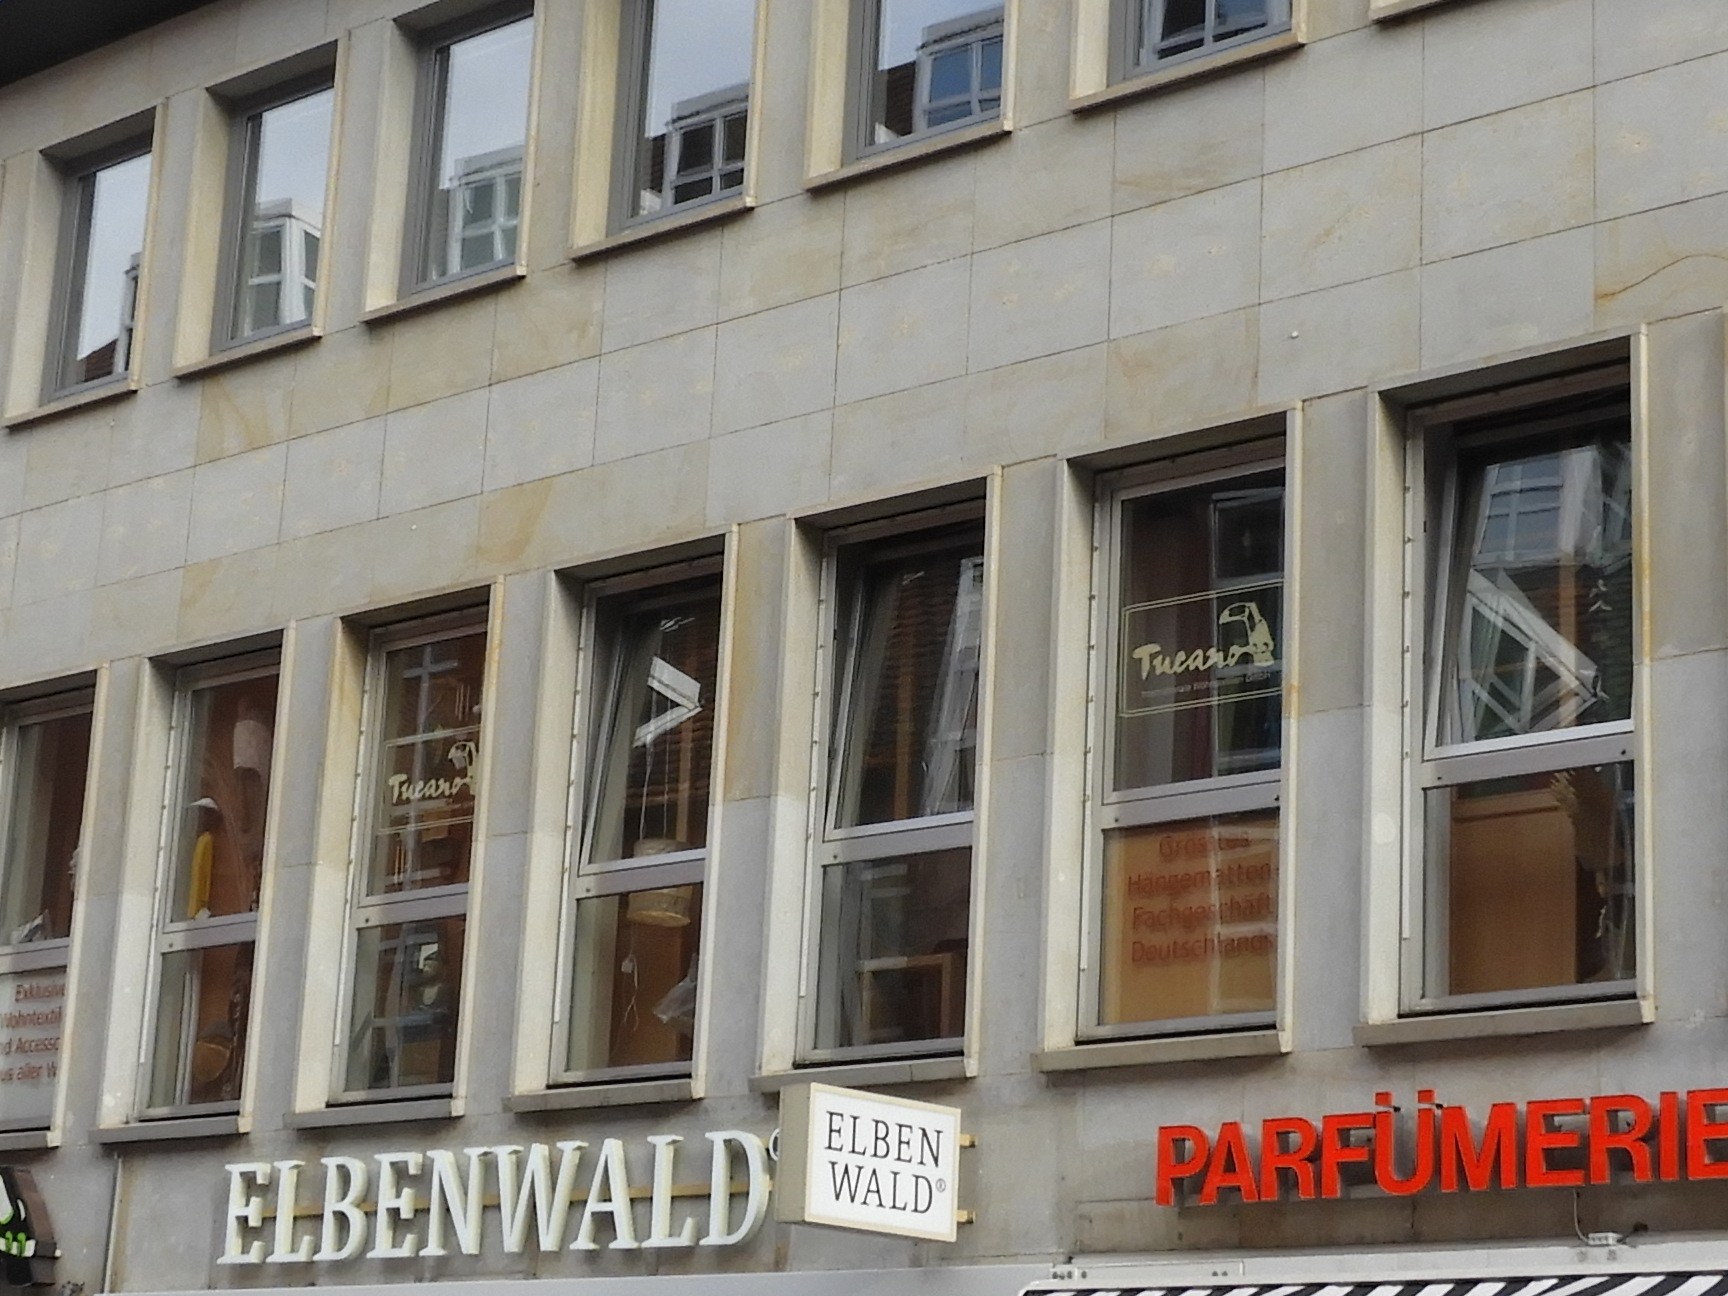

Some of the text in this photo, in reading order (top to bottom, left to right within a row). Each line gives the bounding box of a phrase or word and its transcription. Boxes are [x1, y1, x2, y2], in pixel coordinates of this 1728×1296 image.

[1133, 643, 1242, 681] Tucano
[388, 772, 465, 805] Tucano
[824, 1110, 944, 1168] ELBEN
[216, 1129, 772, 1266] ELBENWALD
